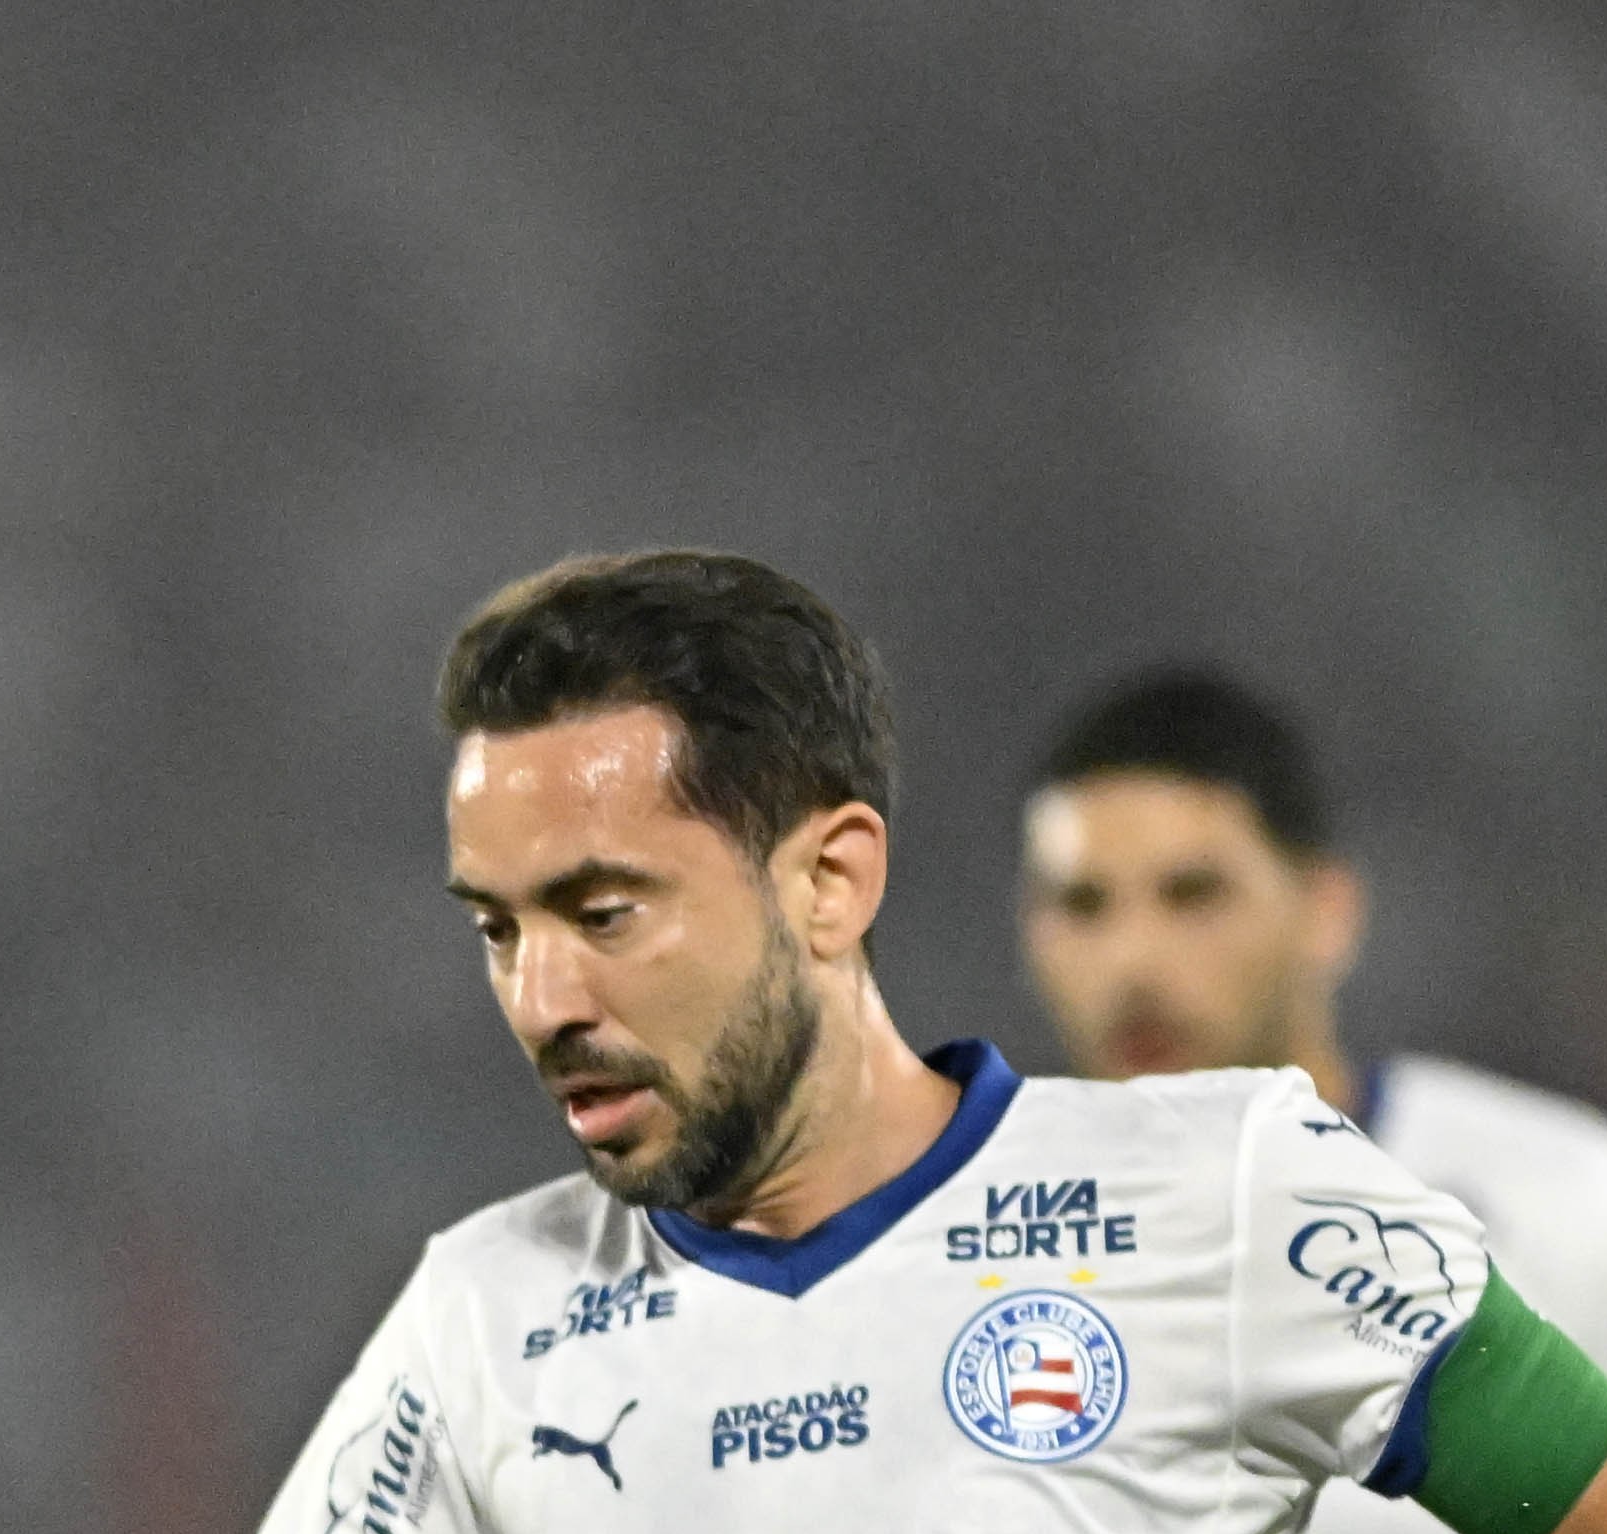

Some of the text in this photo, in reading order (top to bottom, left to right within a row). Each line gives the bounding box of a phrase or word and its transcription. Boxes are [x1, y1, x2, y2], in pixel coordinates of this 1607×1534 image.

[986, 1177, 1098, 1220] VIVA
[946, 1214, 1137, 1261] SORTE
[1288, 1219, 1448, 1341] Cana
[712, 1410, 871, 1469] PISOS
